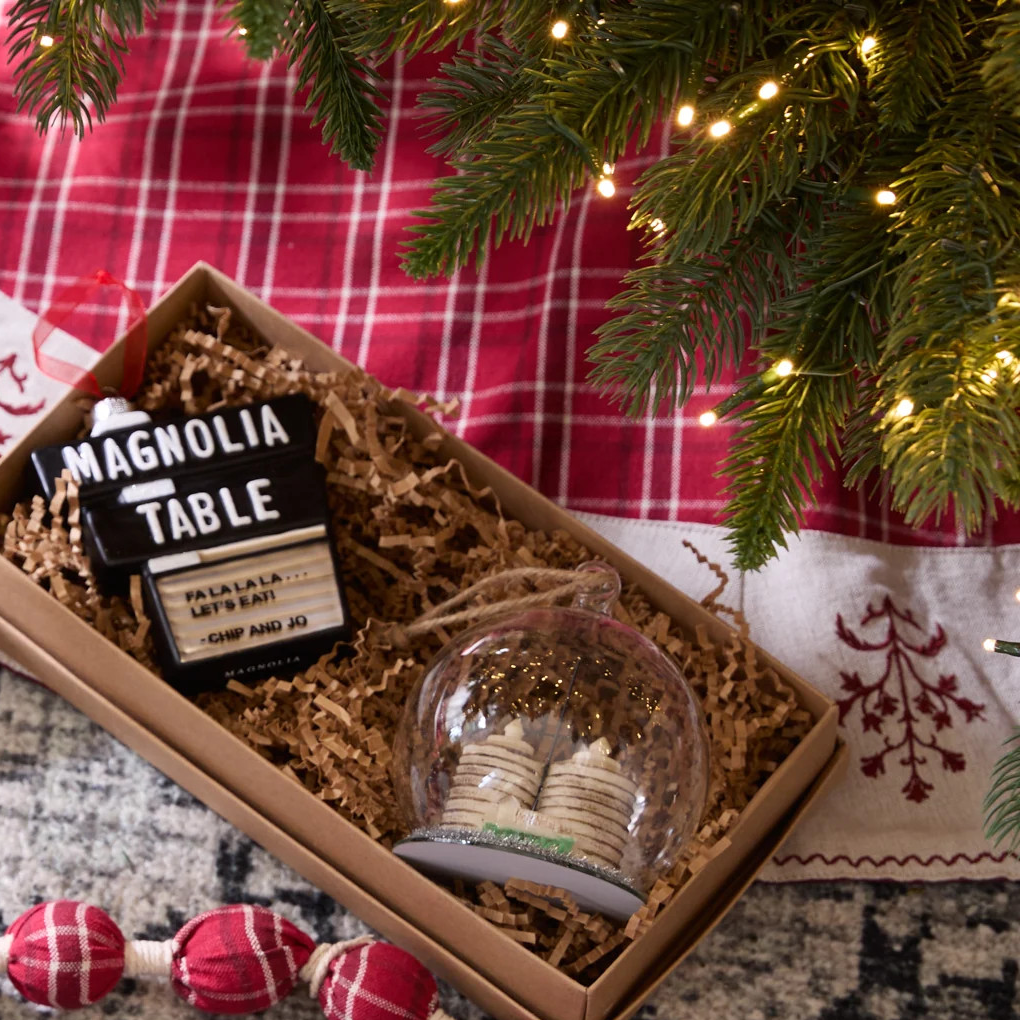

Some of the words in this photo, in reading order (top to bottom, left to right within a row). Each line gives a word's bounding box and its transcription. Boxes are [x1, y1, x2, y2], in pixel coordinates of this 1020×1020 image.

[62, 404, 290, 486] MAGNOLIA
[136, 478, 280, 544] TABLE
[185, 590, 206, 602] FA
[209, 585, 232, 597] LA
[234, 579, 257, 592] LA
[191, 599, 236, 618] LET'S
[240, 589, 276, 608] EAT!
[249, 620, 282, 638] AND
[287, 615, 308, 629] JO
[224, 656, 301, 677] MAGNOLIA
